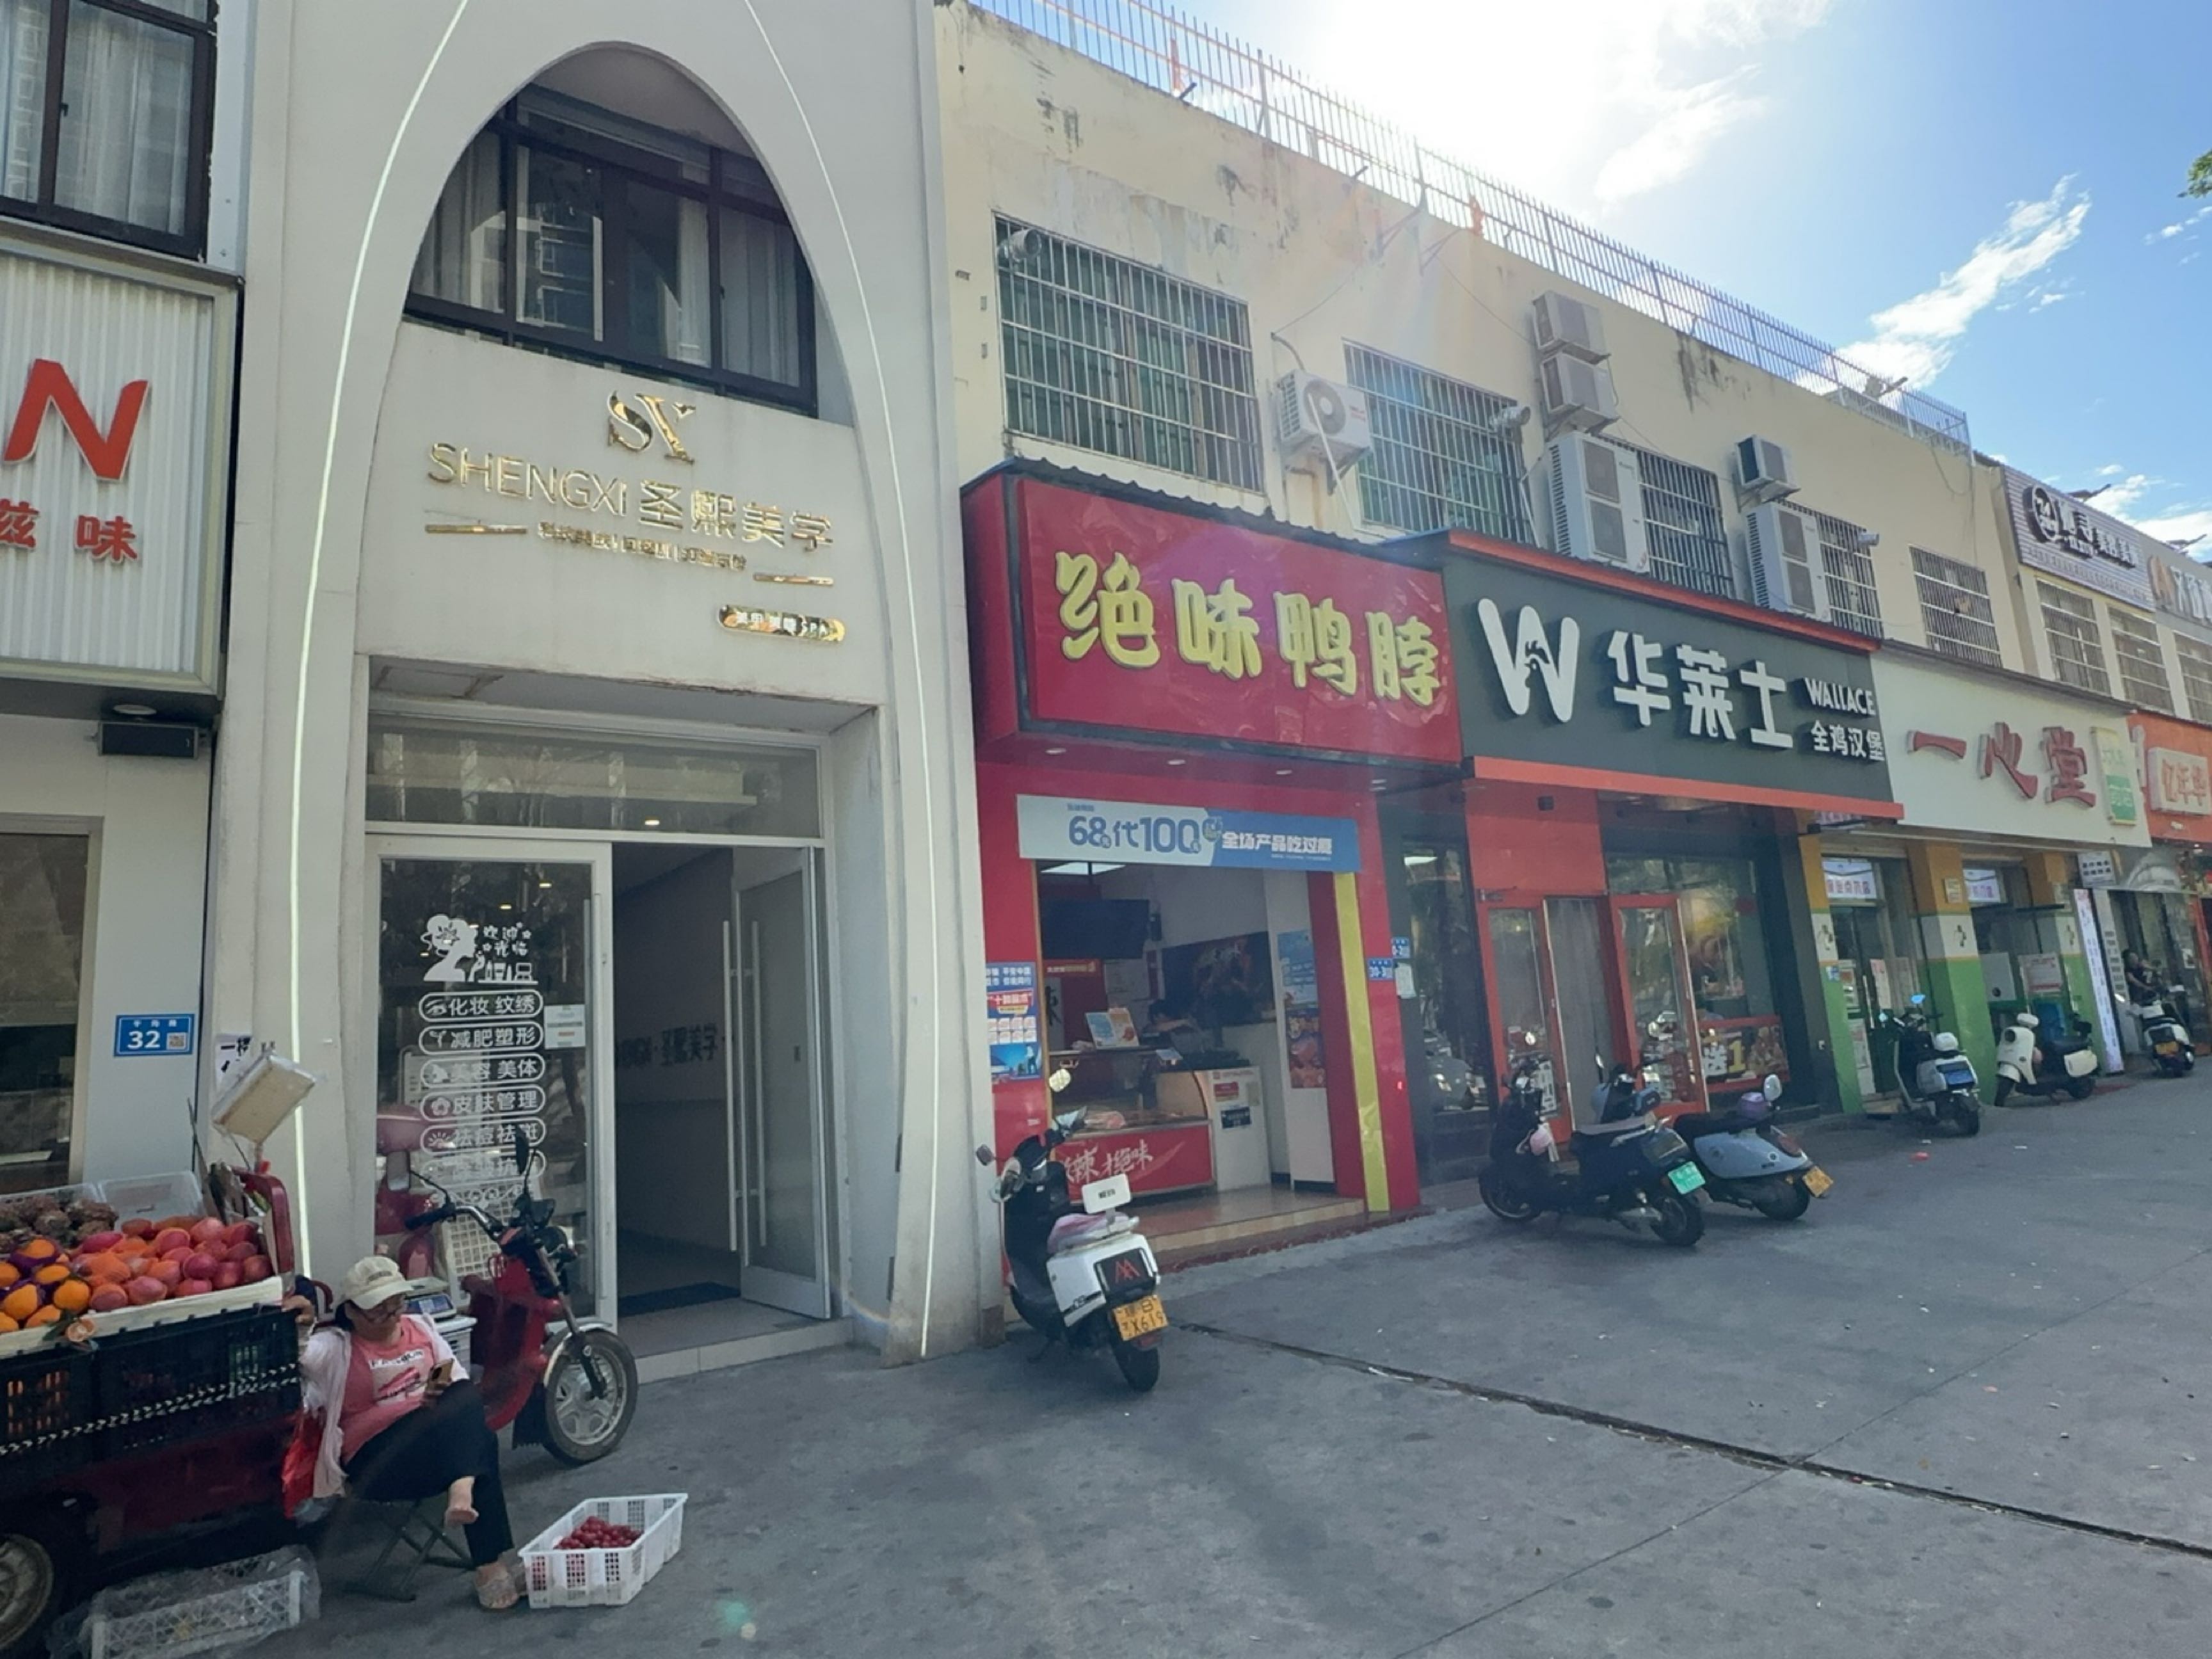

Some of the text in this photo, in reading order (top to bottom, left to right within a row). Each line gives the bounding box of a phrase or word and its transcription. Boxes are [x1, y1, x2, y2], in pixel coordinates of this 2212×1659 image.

[427, 442, 628, 517] SHENGXI
[1055, 552, 1441, 707] 绝味鸭脖
[1608, 630, 1793, 749] 华莱士
[1802, 677, 1876, 716] WALLACE
[1810, 719, 1886, 762] 全鸡汉堡
[1907, 722, 2096, 808] 一心堂
[450, 995, 535, 1016] 化妆 纹绣
[127, 1030, 161, 1050] 32
[451, 1026, 536, 1048] 减肥塑形
[497, 1059, 537, 1079] 美体
[453, 1090, 538, 1114] 皮肤管理
